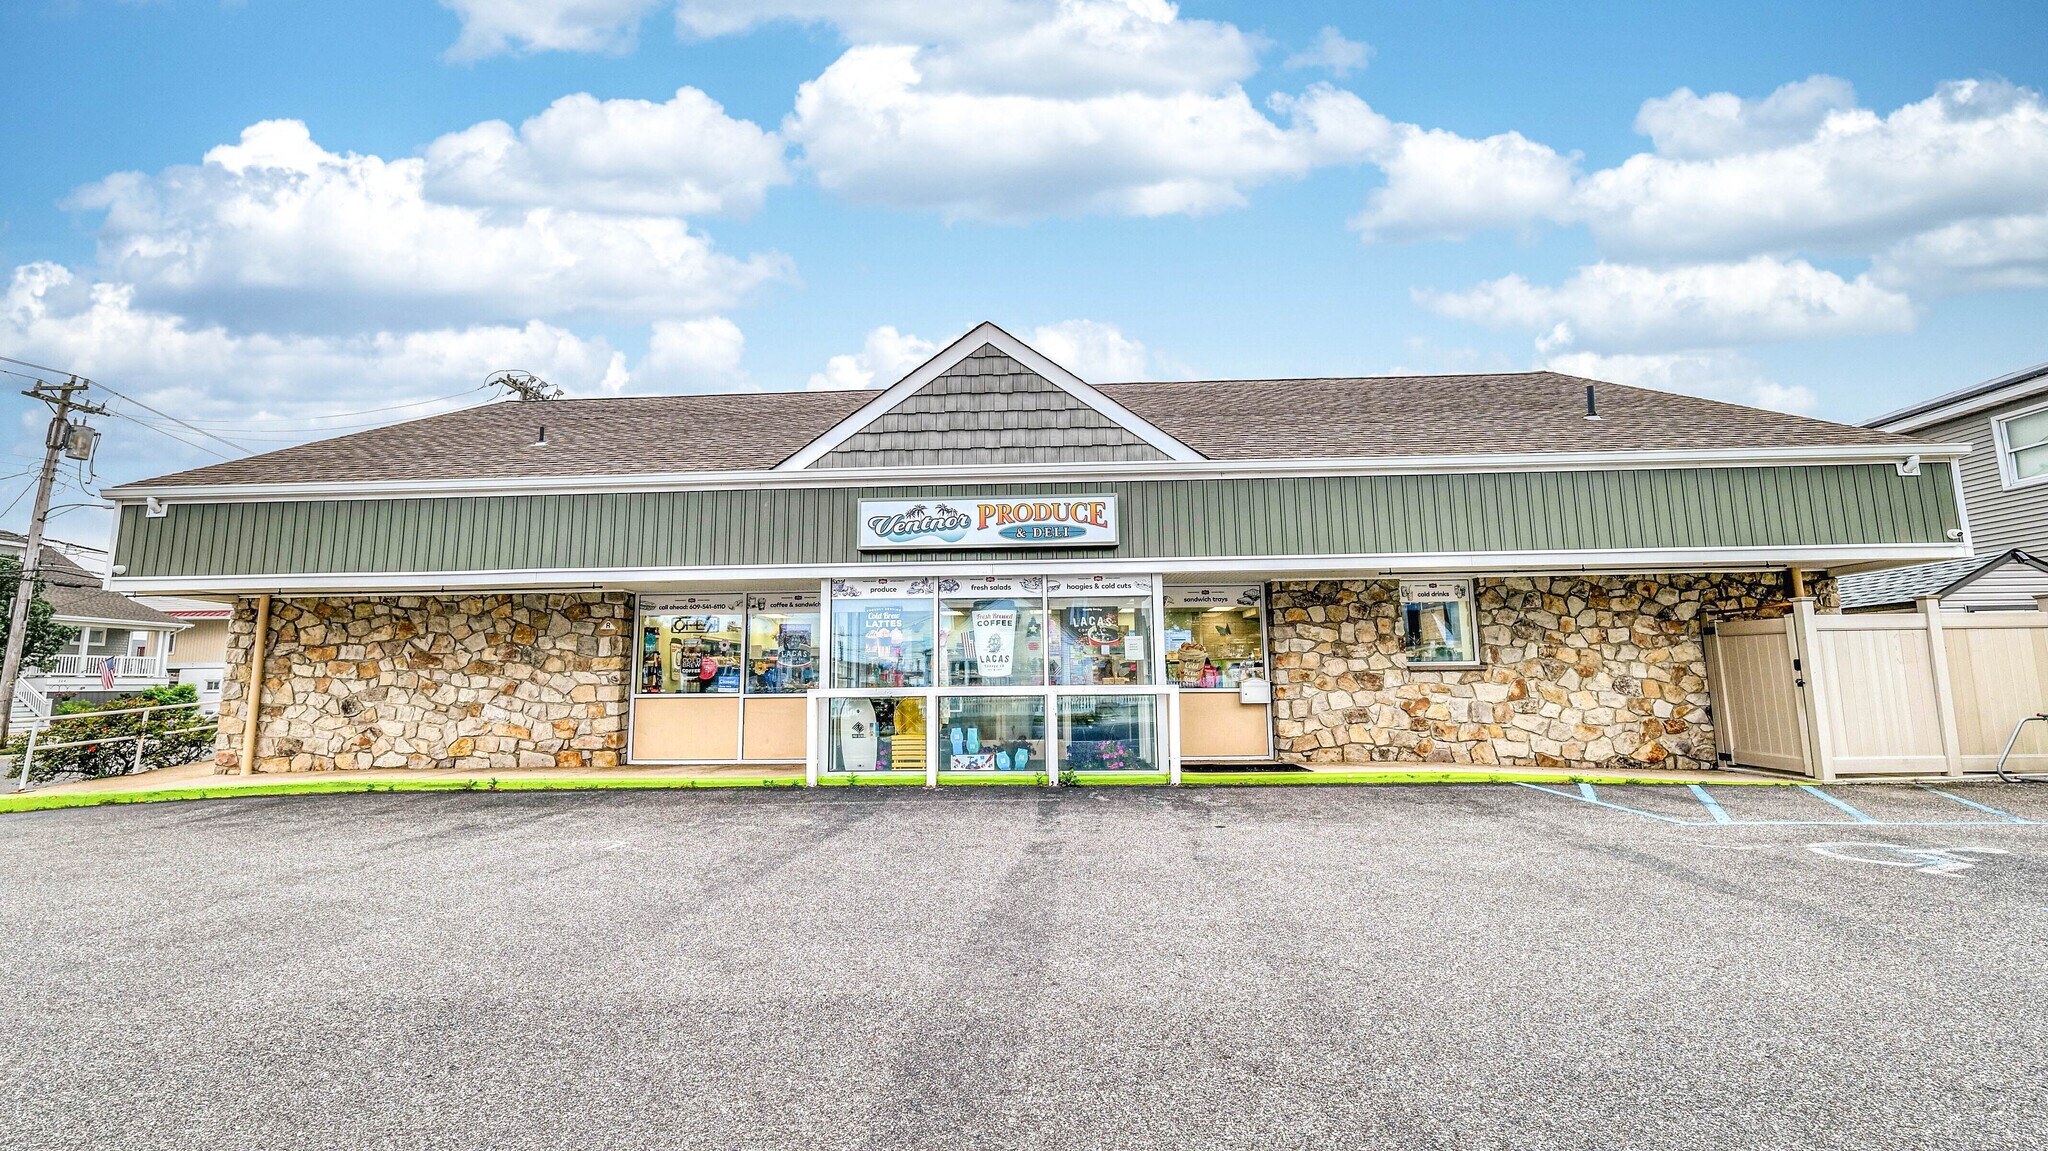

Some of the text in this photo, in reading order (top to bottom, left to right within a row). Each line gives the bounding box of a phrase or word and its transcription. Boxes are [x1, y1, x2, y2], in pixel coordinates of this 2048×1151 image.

[977, 501, 1108, 530] PRODUCE
[868, 513, 971, 537] Ventnor
[1016, 527, 1069, 538] & DELI
[870, 586, 897, 594] produce
[1066, 583, 1093, 591] hoagies
[865, 619, 903, 628] LATTES
[977, 619, 1013, 627] COFFEE
[1073, 616, 1113, 628] LACAS
[781, 650, 808, 658] LACAS
[979, 655, 1010, 664] LACAS
